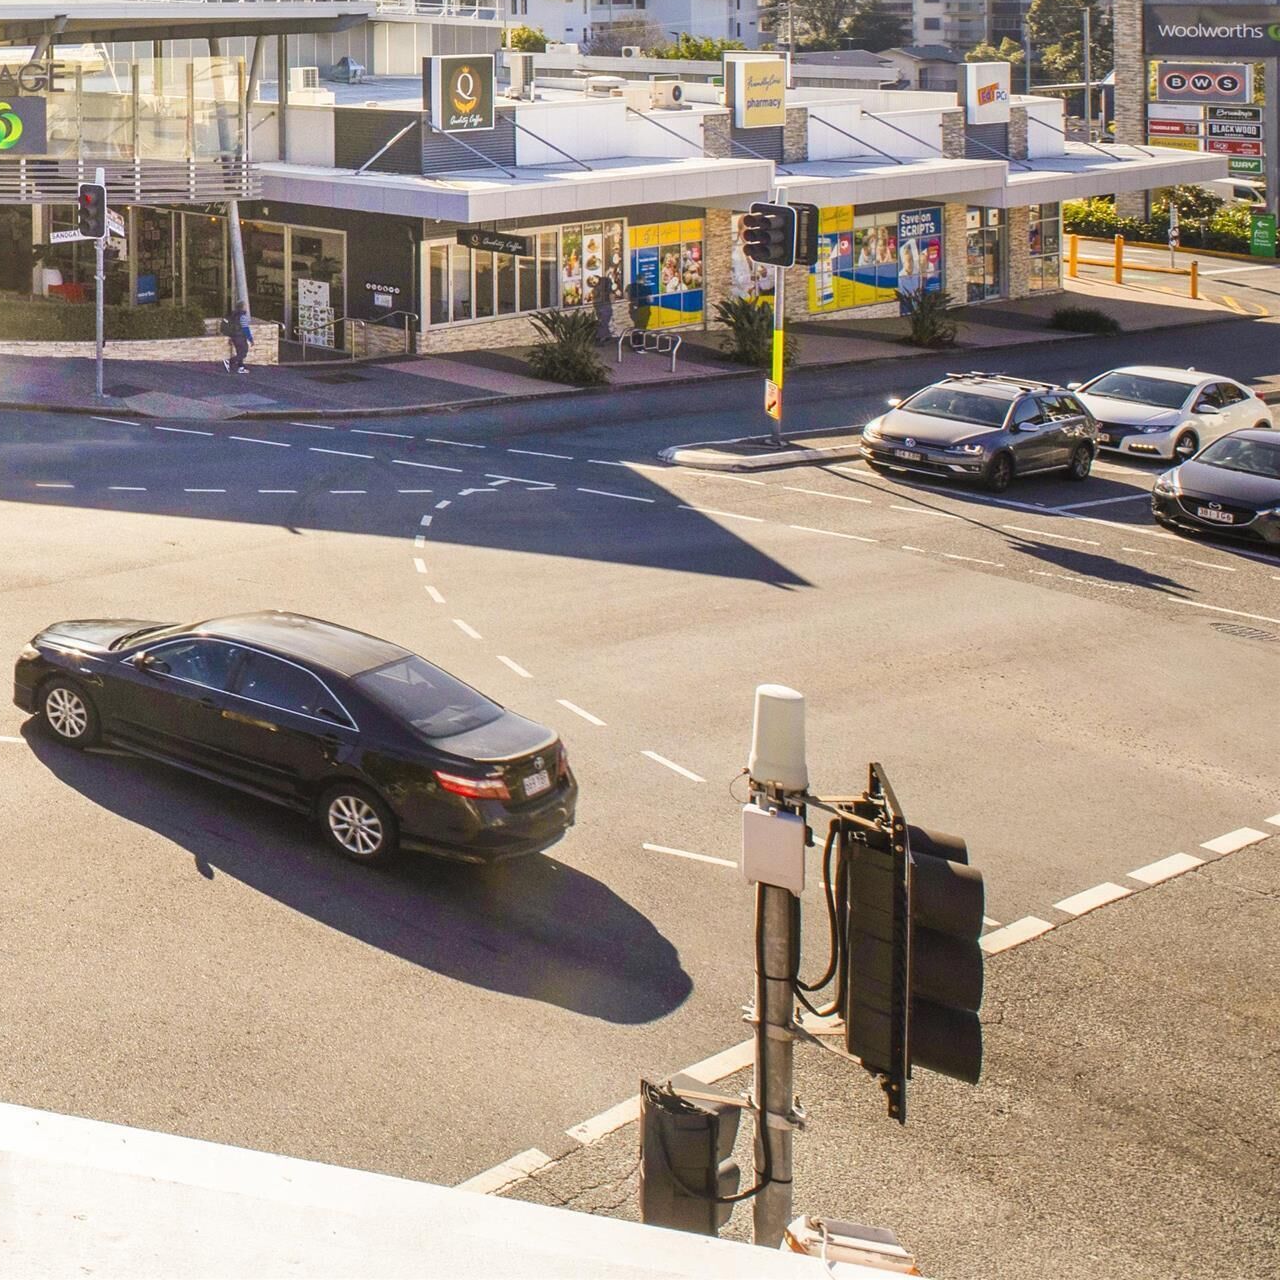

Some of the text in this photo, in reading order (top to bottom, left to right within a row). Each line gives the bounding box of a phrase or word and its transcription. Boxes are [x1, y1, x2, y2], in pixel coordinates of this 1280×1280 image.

[1157, 23, 1264, 39] Woolworths
[901, 213, 931, 225] Save on
[901, 222, 935, 237] SCRIPTS
